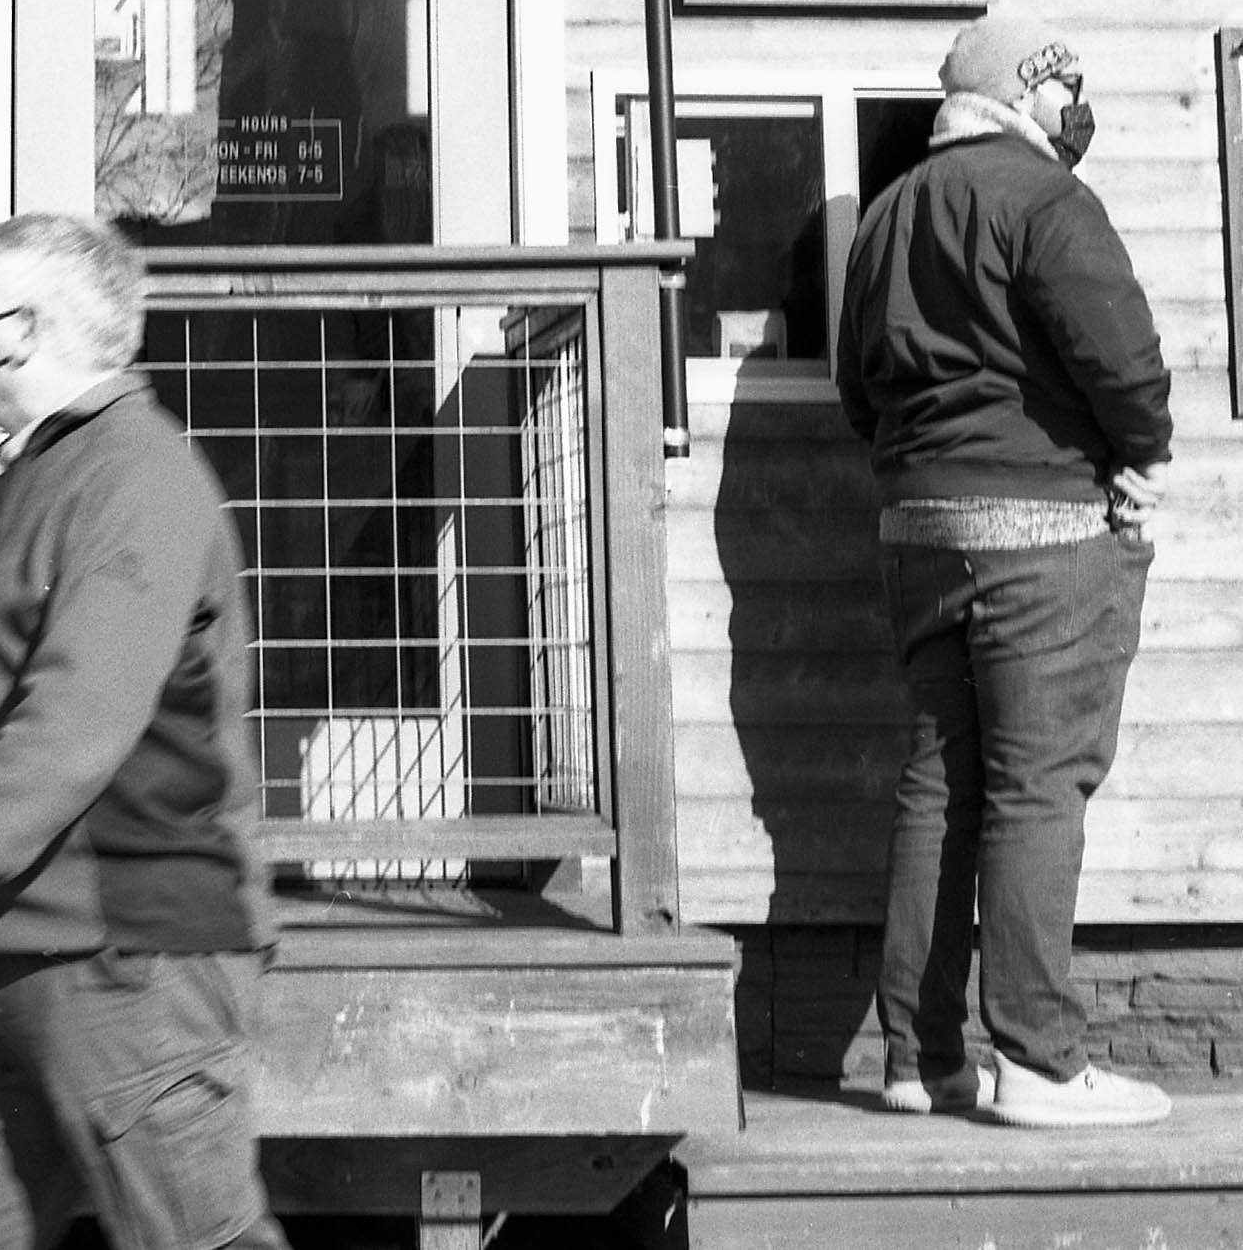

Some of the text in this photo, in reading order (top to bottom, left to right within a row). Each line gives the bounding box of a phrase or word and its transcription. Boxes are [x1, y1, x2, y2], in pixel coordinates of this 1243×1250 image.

[240, 115, 288, 133] HOURS
[254, 140, 278, 160] FRI
[219, 164, 287, 185] EEKENDS
